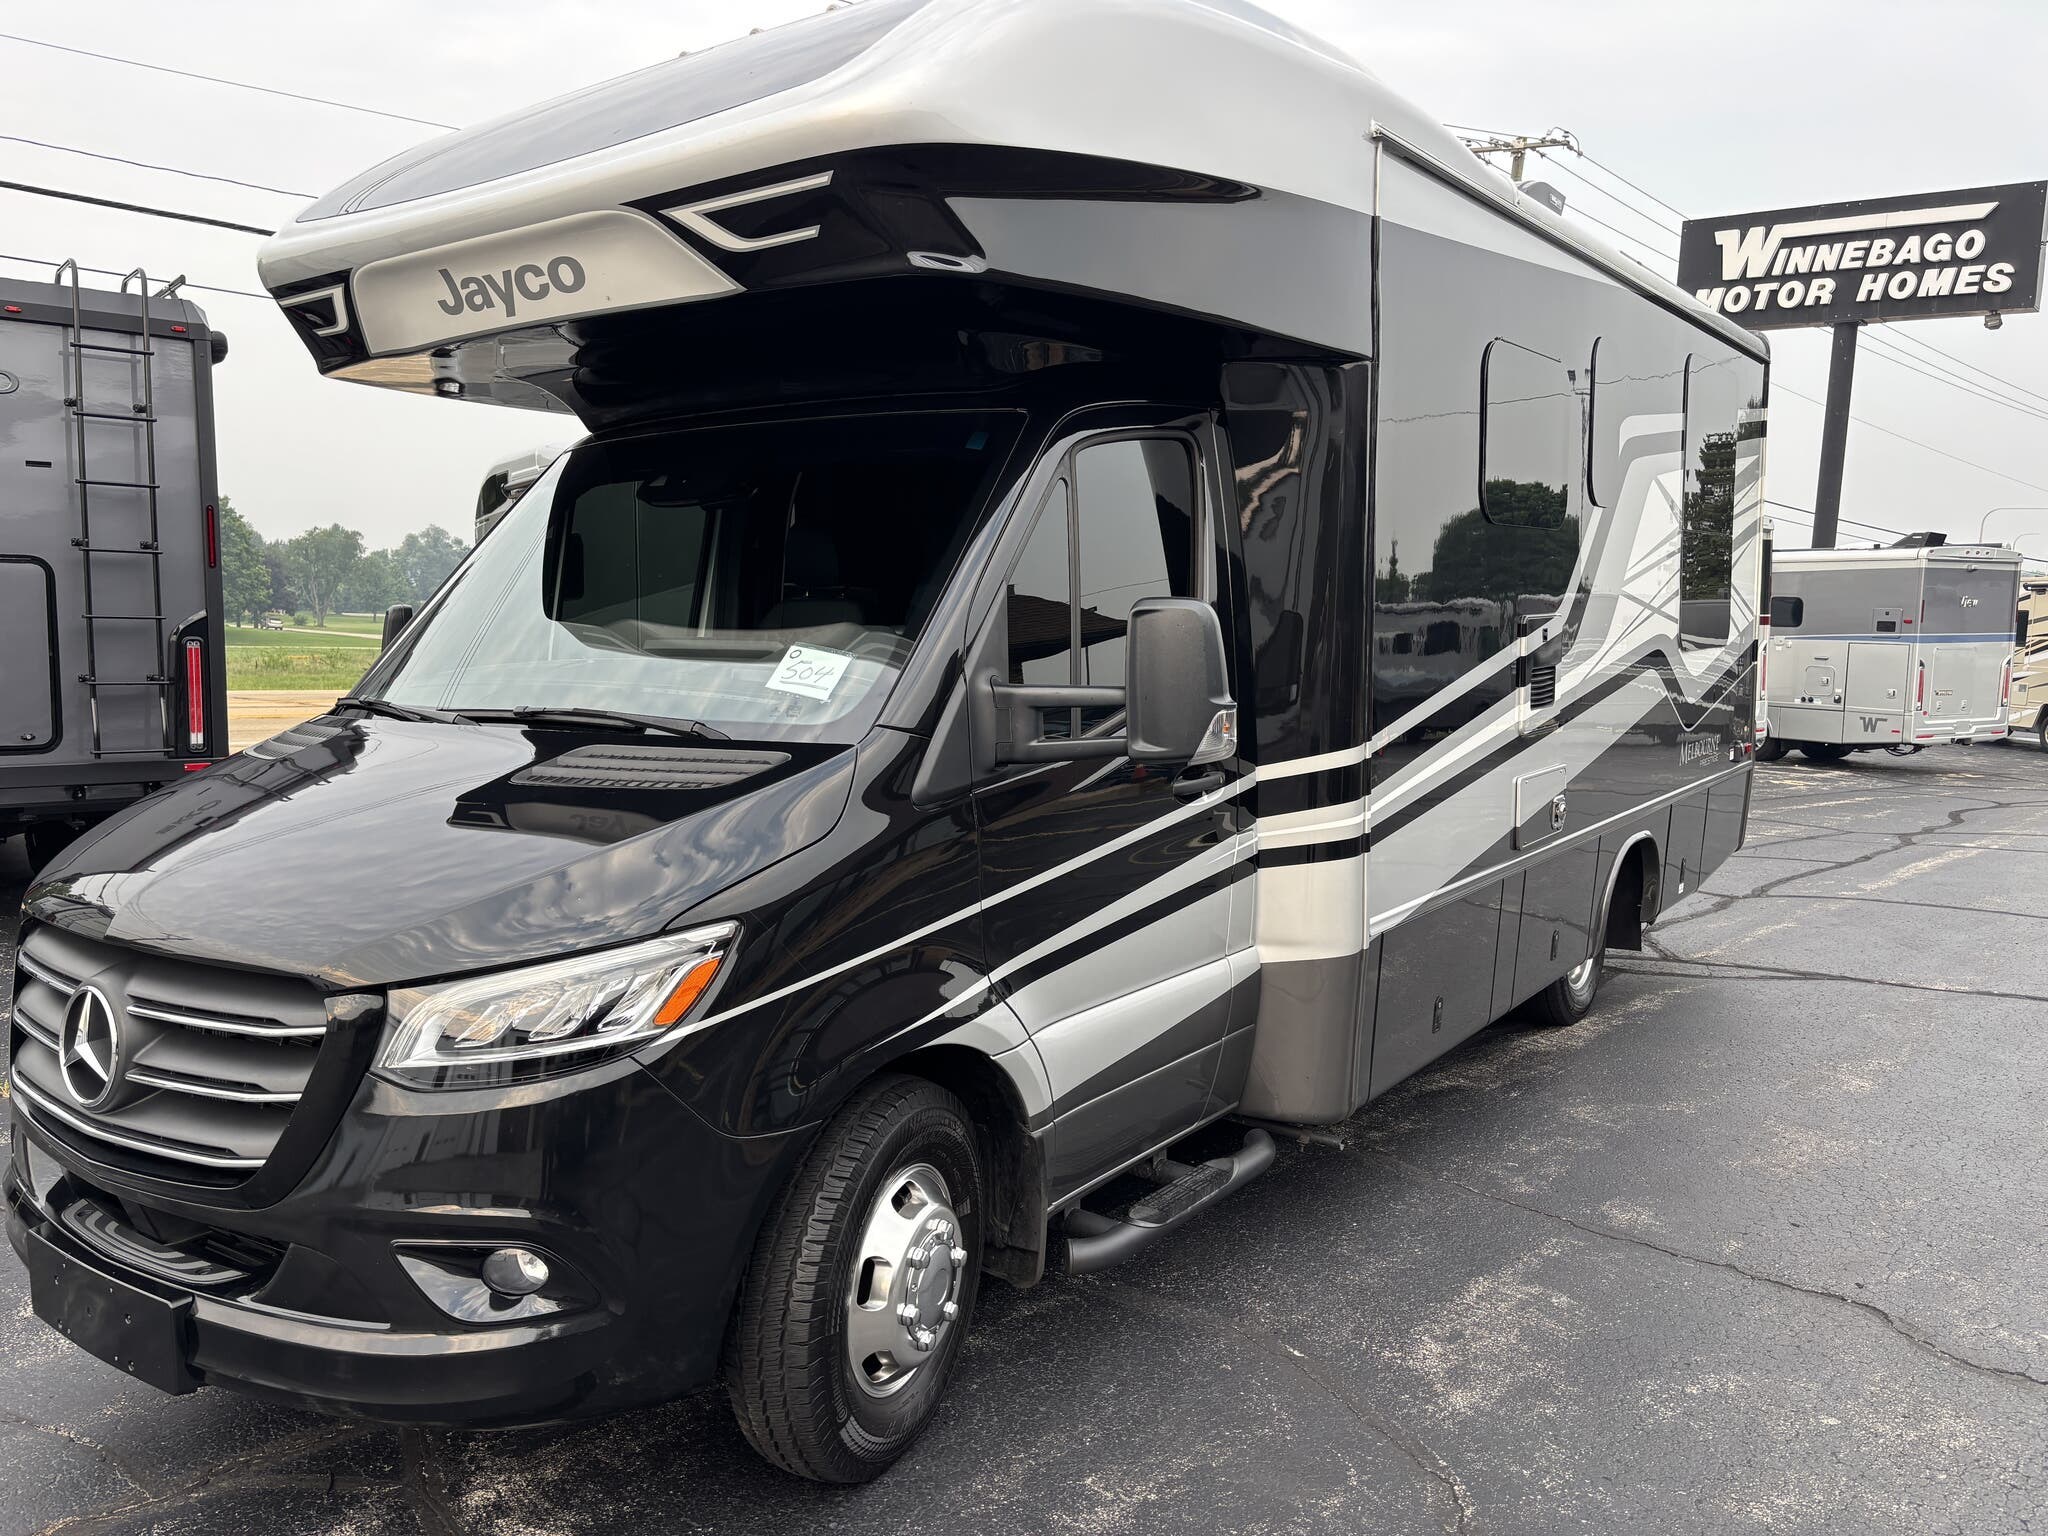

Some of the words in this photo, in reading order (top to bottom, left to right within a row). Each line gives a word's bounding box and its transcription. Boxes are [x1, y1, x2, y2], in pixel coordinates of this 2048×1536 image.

[1714, 201, 2000, 281] WINNEBAGO
[437, 256, 586, 318] Jayco
[1695, 277, 1836, 313] MOTOR
[1855, 262, 2016, 302] HOMES
[781, 660, 835, 683] 504
